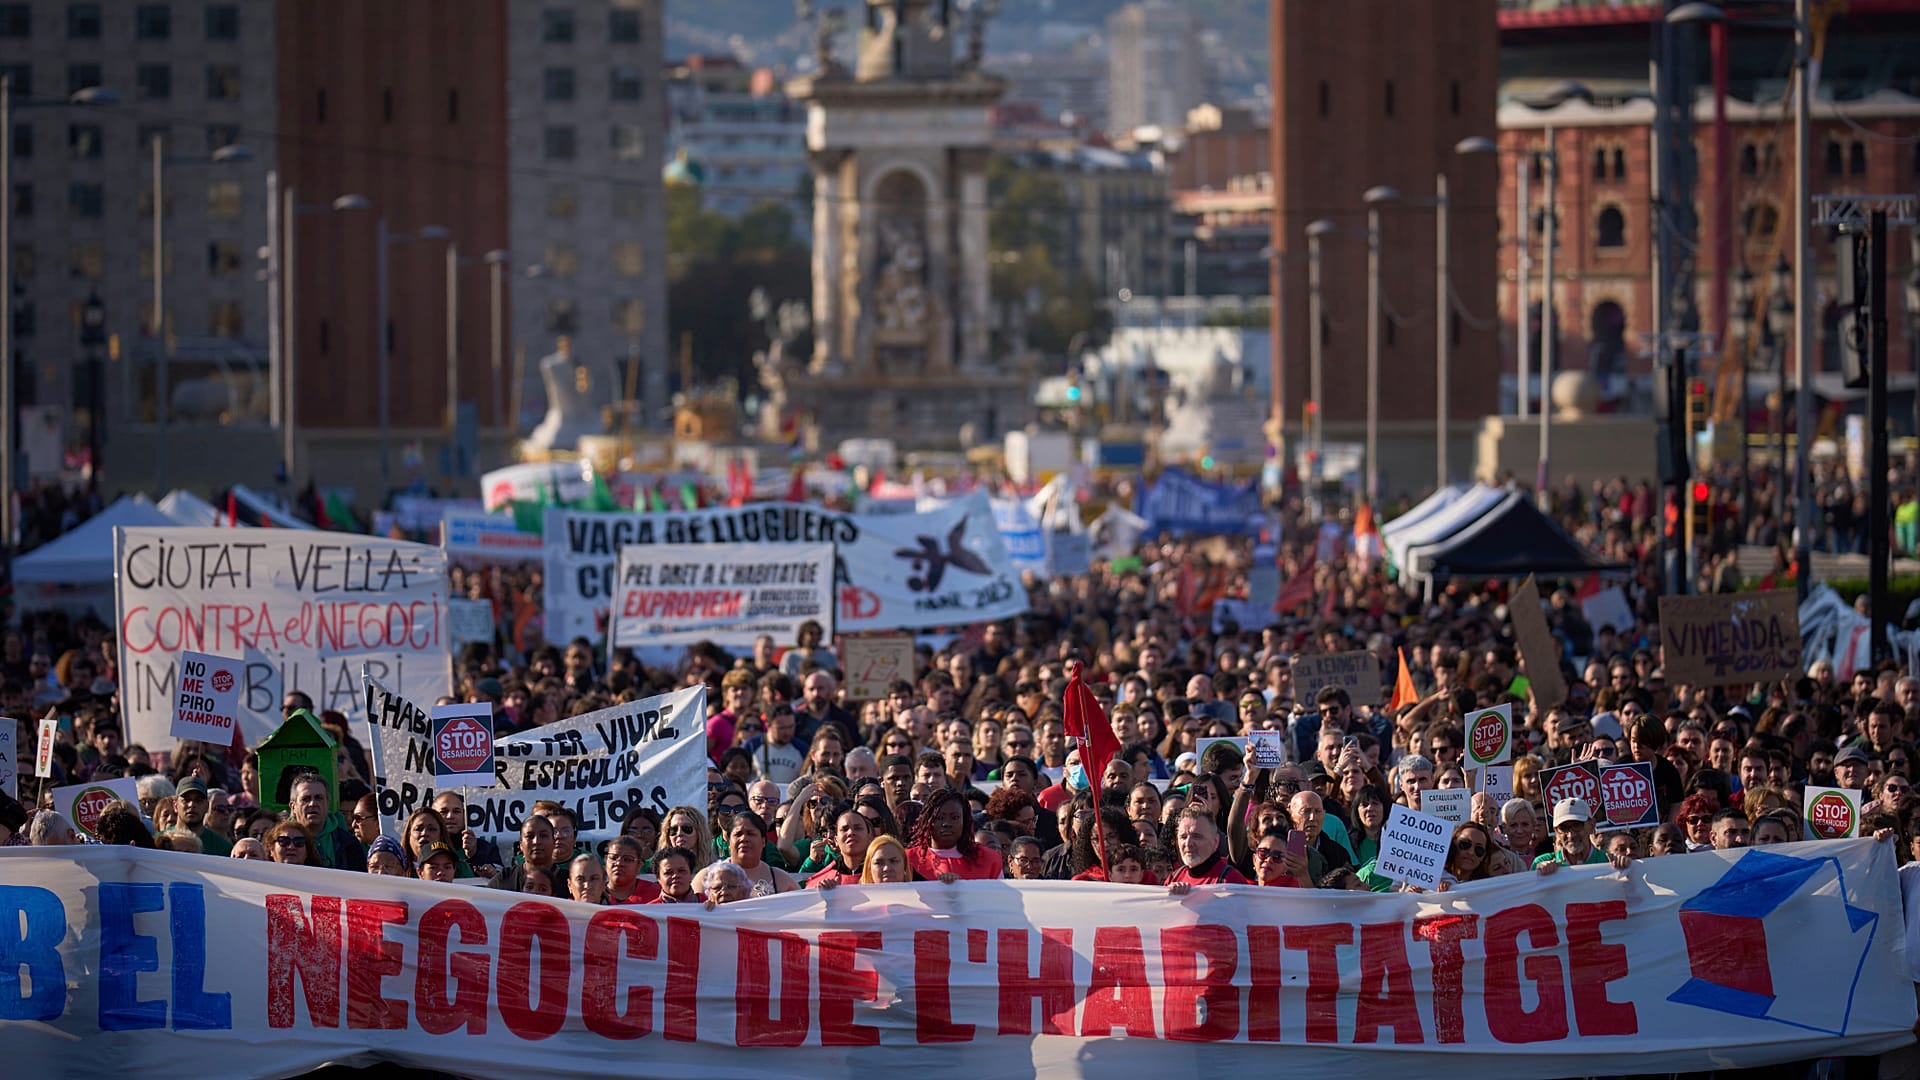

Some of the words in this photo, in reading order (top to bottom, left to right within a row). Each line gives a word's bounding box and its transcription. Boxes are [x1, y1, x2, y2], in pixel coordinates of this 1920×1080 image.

[567, 516, 655, 553] VAGA
[126, 538, 266, 589] CIUTAT
[289, 544, 418, 592] VELLA
[624, 589, 744, 618] EXPROPIEM
[123, 601, 282, 652] CONTRA
[318, 592, 440, 652] NEGOCI
[1668, 614, 1786, 657] VIVIENDA
[185, 661, 206, 677] NO
[182, 677, 205, 694] ME
[179, 694, 215, 712] PIRO
[178, 709, 232, 729] VAMPIRO
[441, 731, 487, 750] STOP
[1475, 723, 1502, 741] STOP
[441, 748, 487, 759] DESAHUCIOS
[522, 749, 641, 790] ESPECULAR
[1550, 778, 1596, 805] STOP
[1602, 780, 1647, 801] STOP
[1606, 798, 1649, 811] ESAHUCIOS
[1816, 804, 1848, 819] STOP
[1400, 814, 1443, 835] 20.000
[1388, 830, 1446, 854] ALQUILERES
[1390, 847, 1435, 867] SOCIALES
[1382, 861, 1397, 872] EN
[1398, 866, 1404, 874] 6
[1406, 867, 1434, 883] AÑOS
[98, 881, 232, 1031] EL
[265, 893, 701, 1042] NEGOCI
[735, 928, 883, 1047] DE
[914, 900, 1638, 1045] L'HABITATGE
